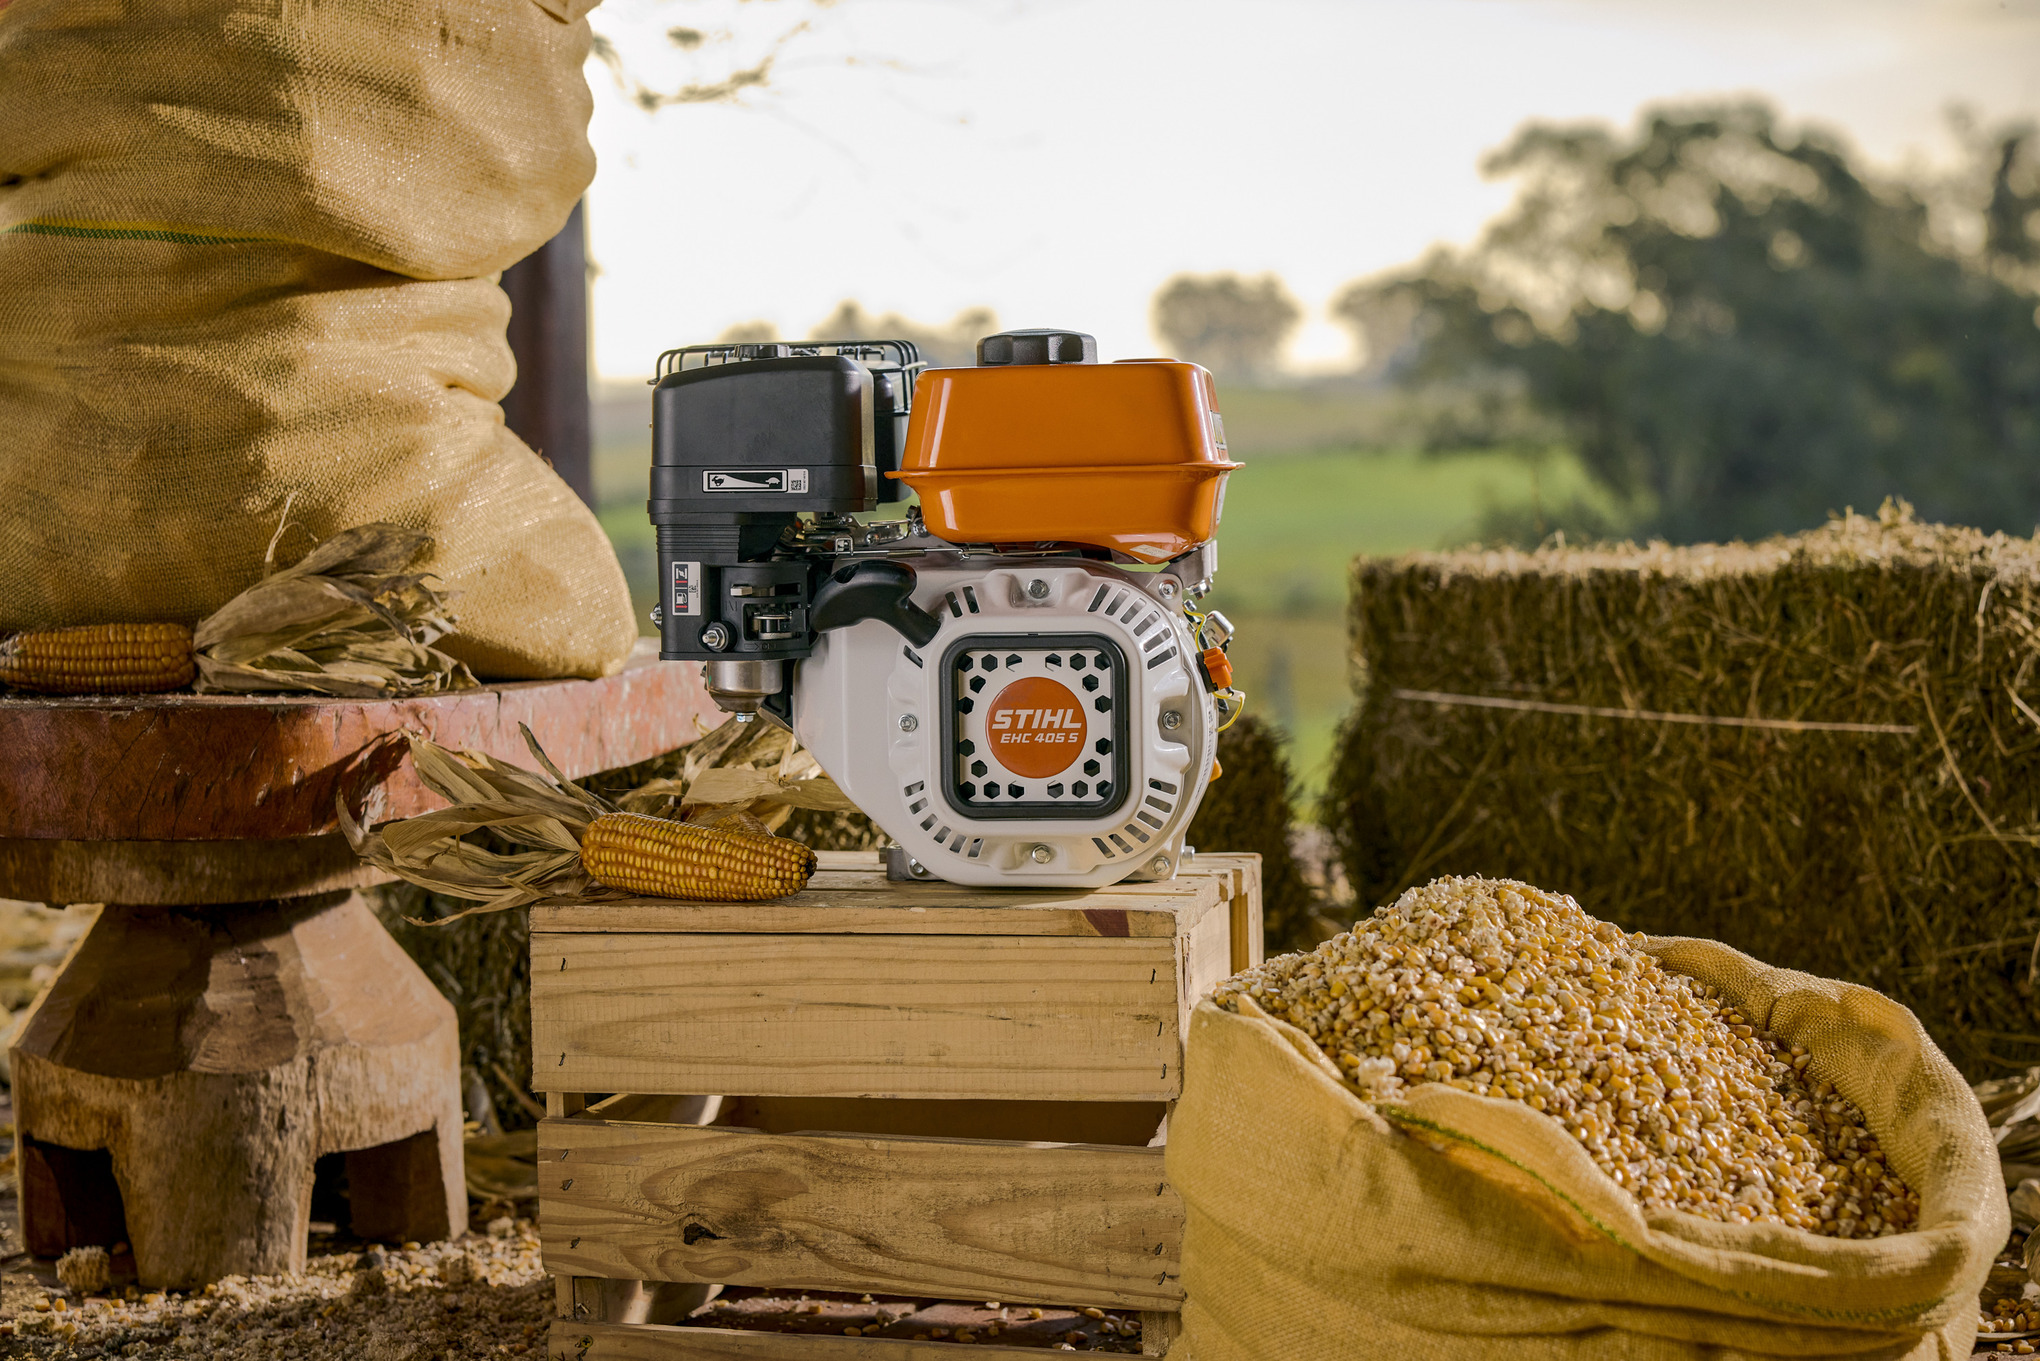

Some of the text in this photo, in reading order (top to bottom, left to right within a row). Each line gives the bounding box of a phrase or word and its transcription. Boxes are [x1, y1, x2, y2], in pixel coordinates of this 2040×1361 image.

[992, 709, 1082, 729] STIHL
[1000, 733, 1078, 743] EHC 405 S
